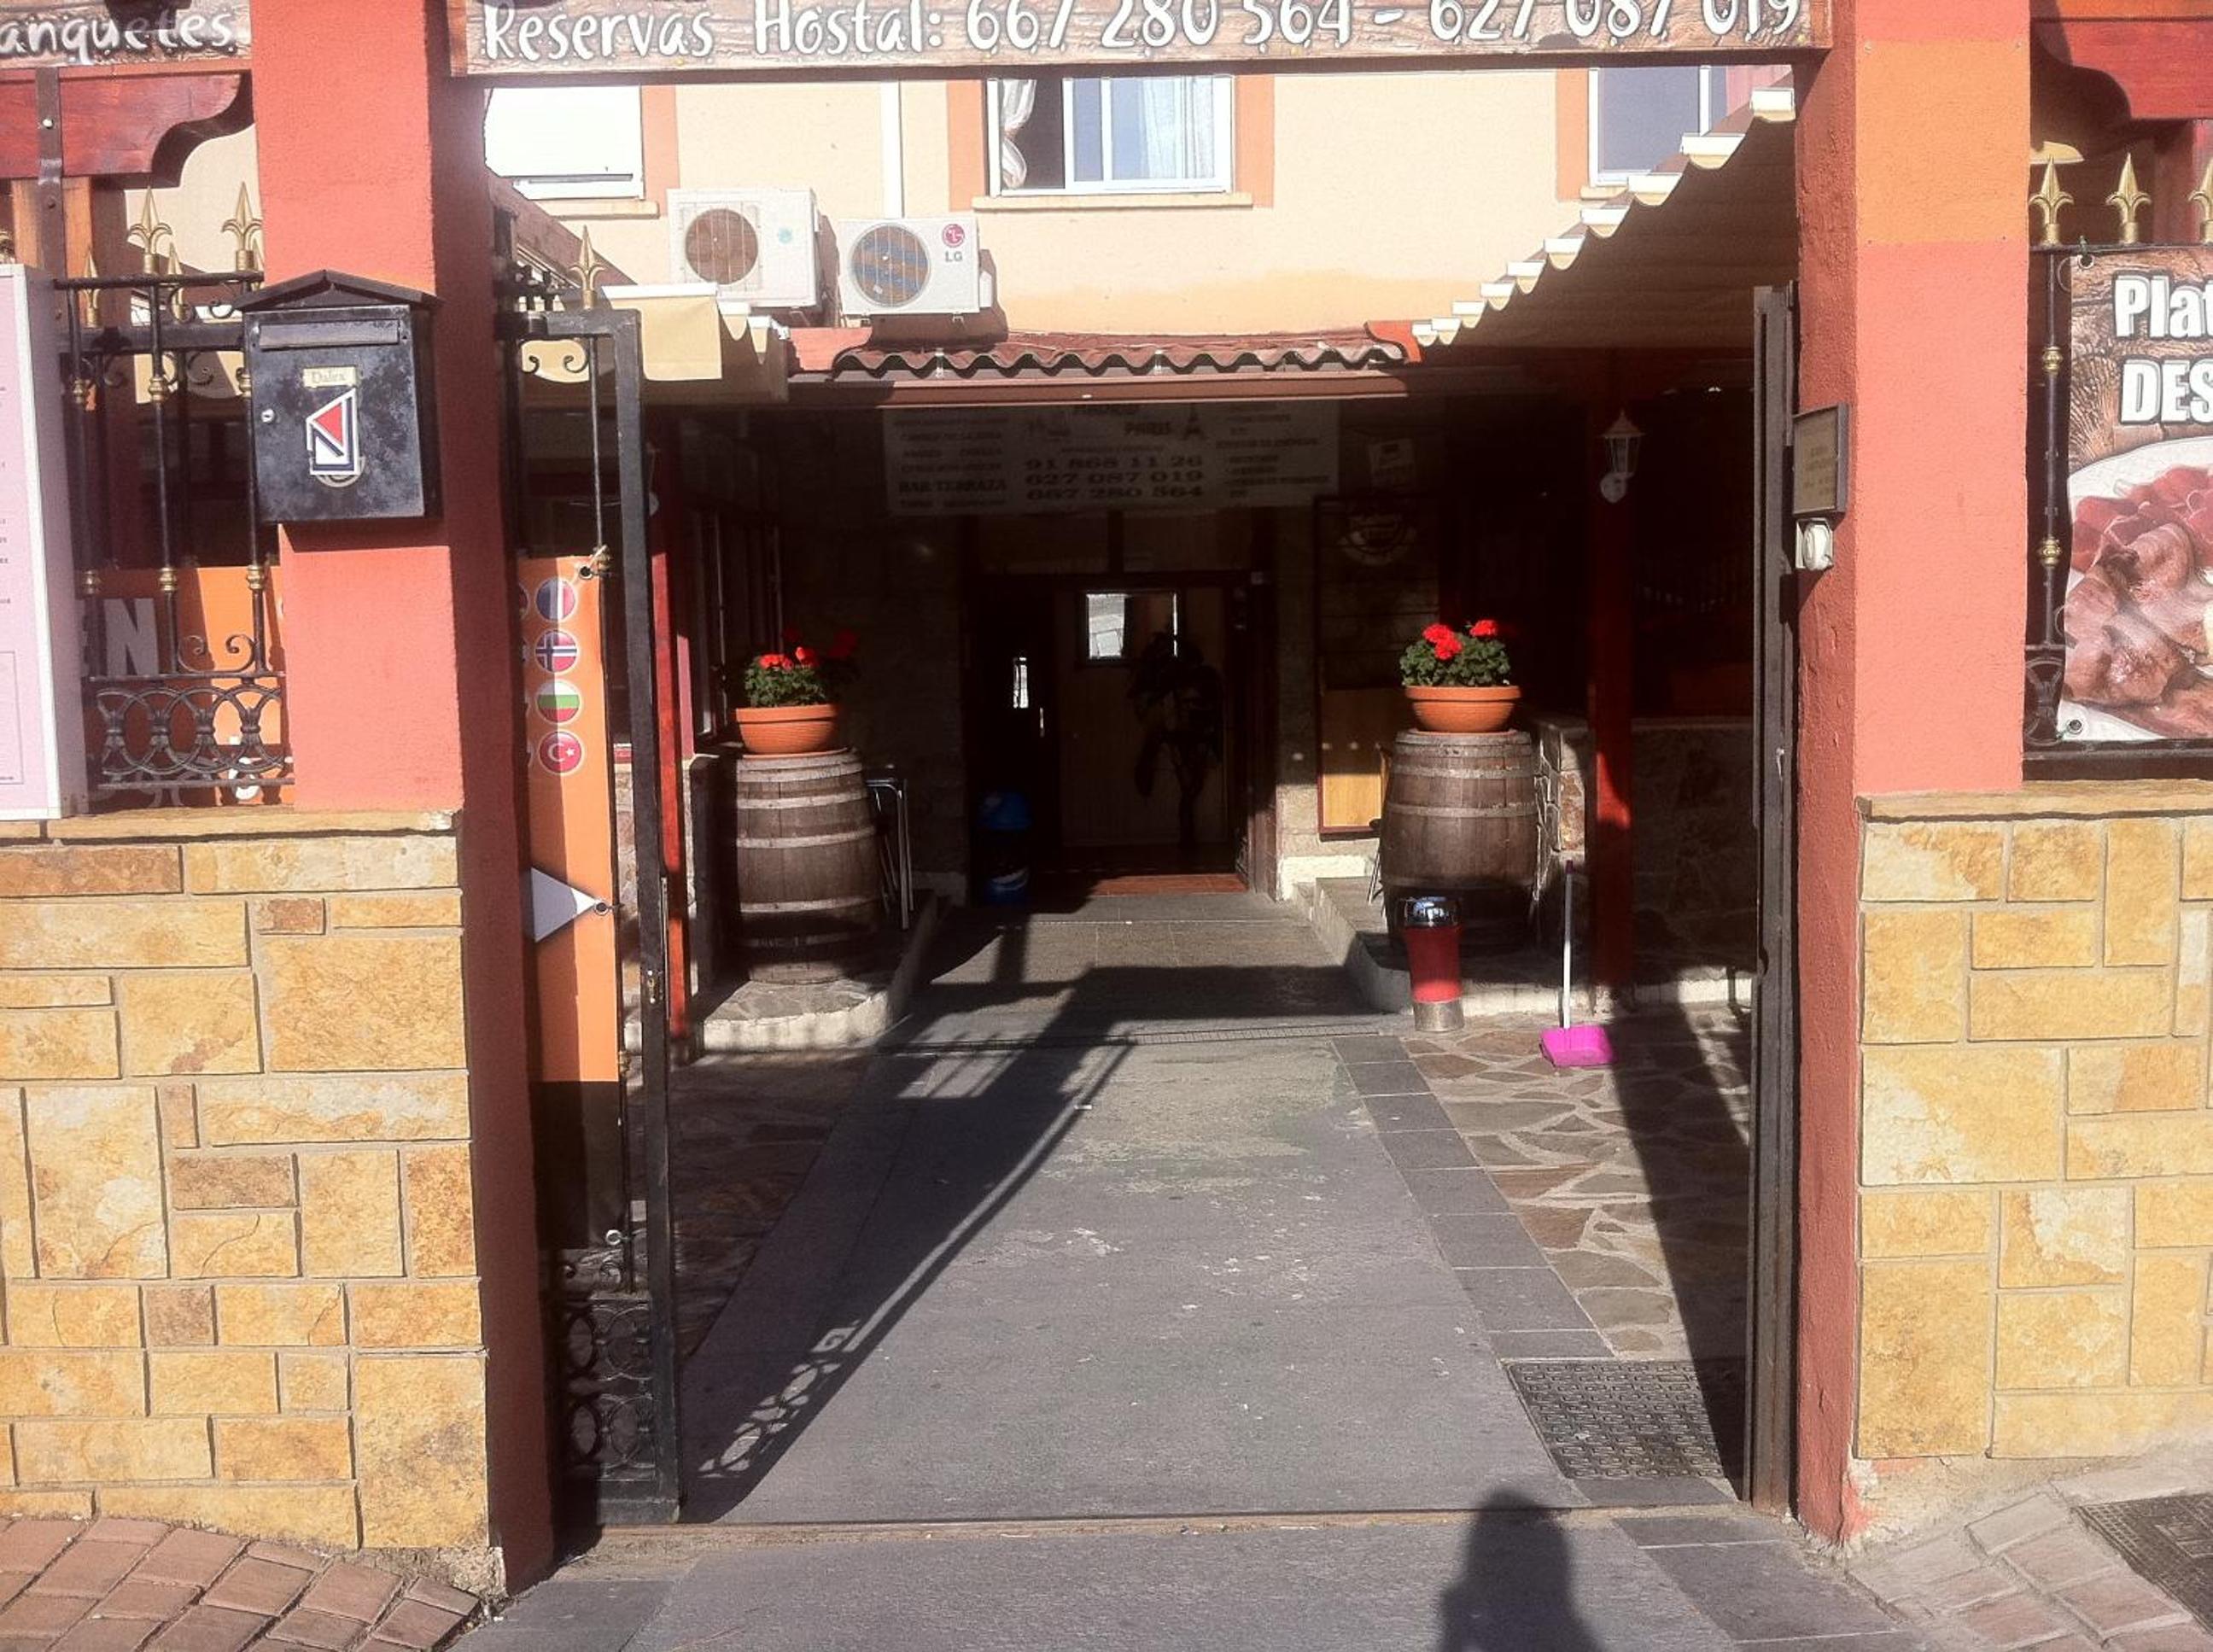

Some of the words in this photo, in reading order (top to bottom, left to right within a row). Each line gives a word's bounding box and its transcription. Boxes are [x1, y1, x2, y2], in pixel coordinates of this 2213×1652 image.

[482, 0, 714, 61] Reservas
[754, 0, 943, 55] Hostal:
[966, 0, 1076, 50] 667
[1101, 0, 1218, 48] 280
[1241, 0, 1354, 46] 564
[1429, 0, 1537, 42] 627
[1565, 0, 1672, 38] 087
[1701, 0, 1802, 36] 019
[944, 251, 963, 263] LG
[2120, 359, 2213, 423] DES
[1025, 458, 1058, 470] 91
[1130, 455, 1158, 469] 11
[1025, 471, 1079, 486] 627
[1088, 470, 1142, 485] 087
[1150, 470, 1205, 483] 019
